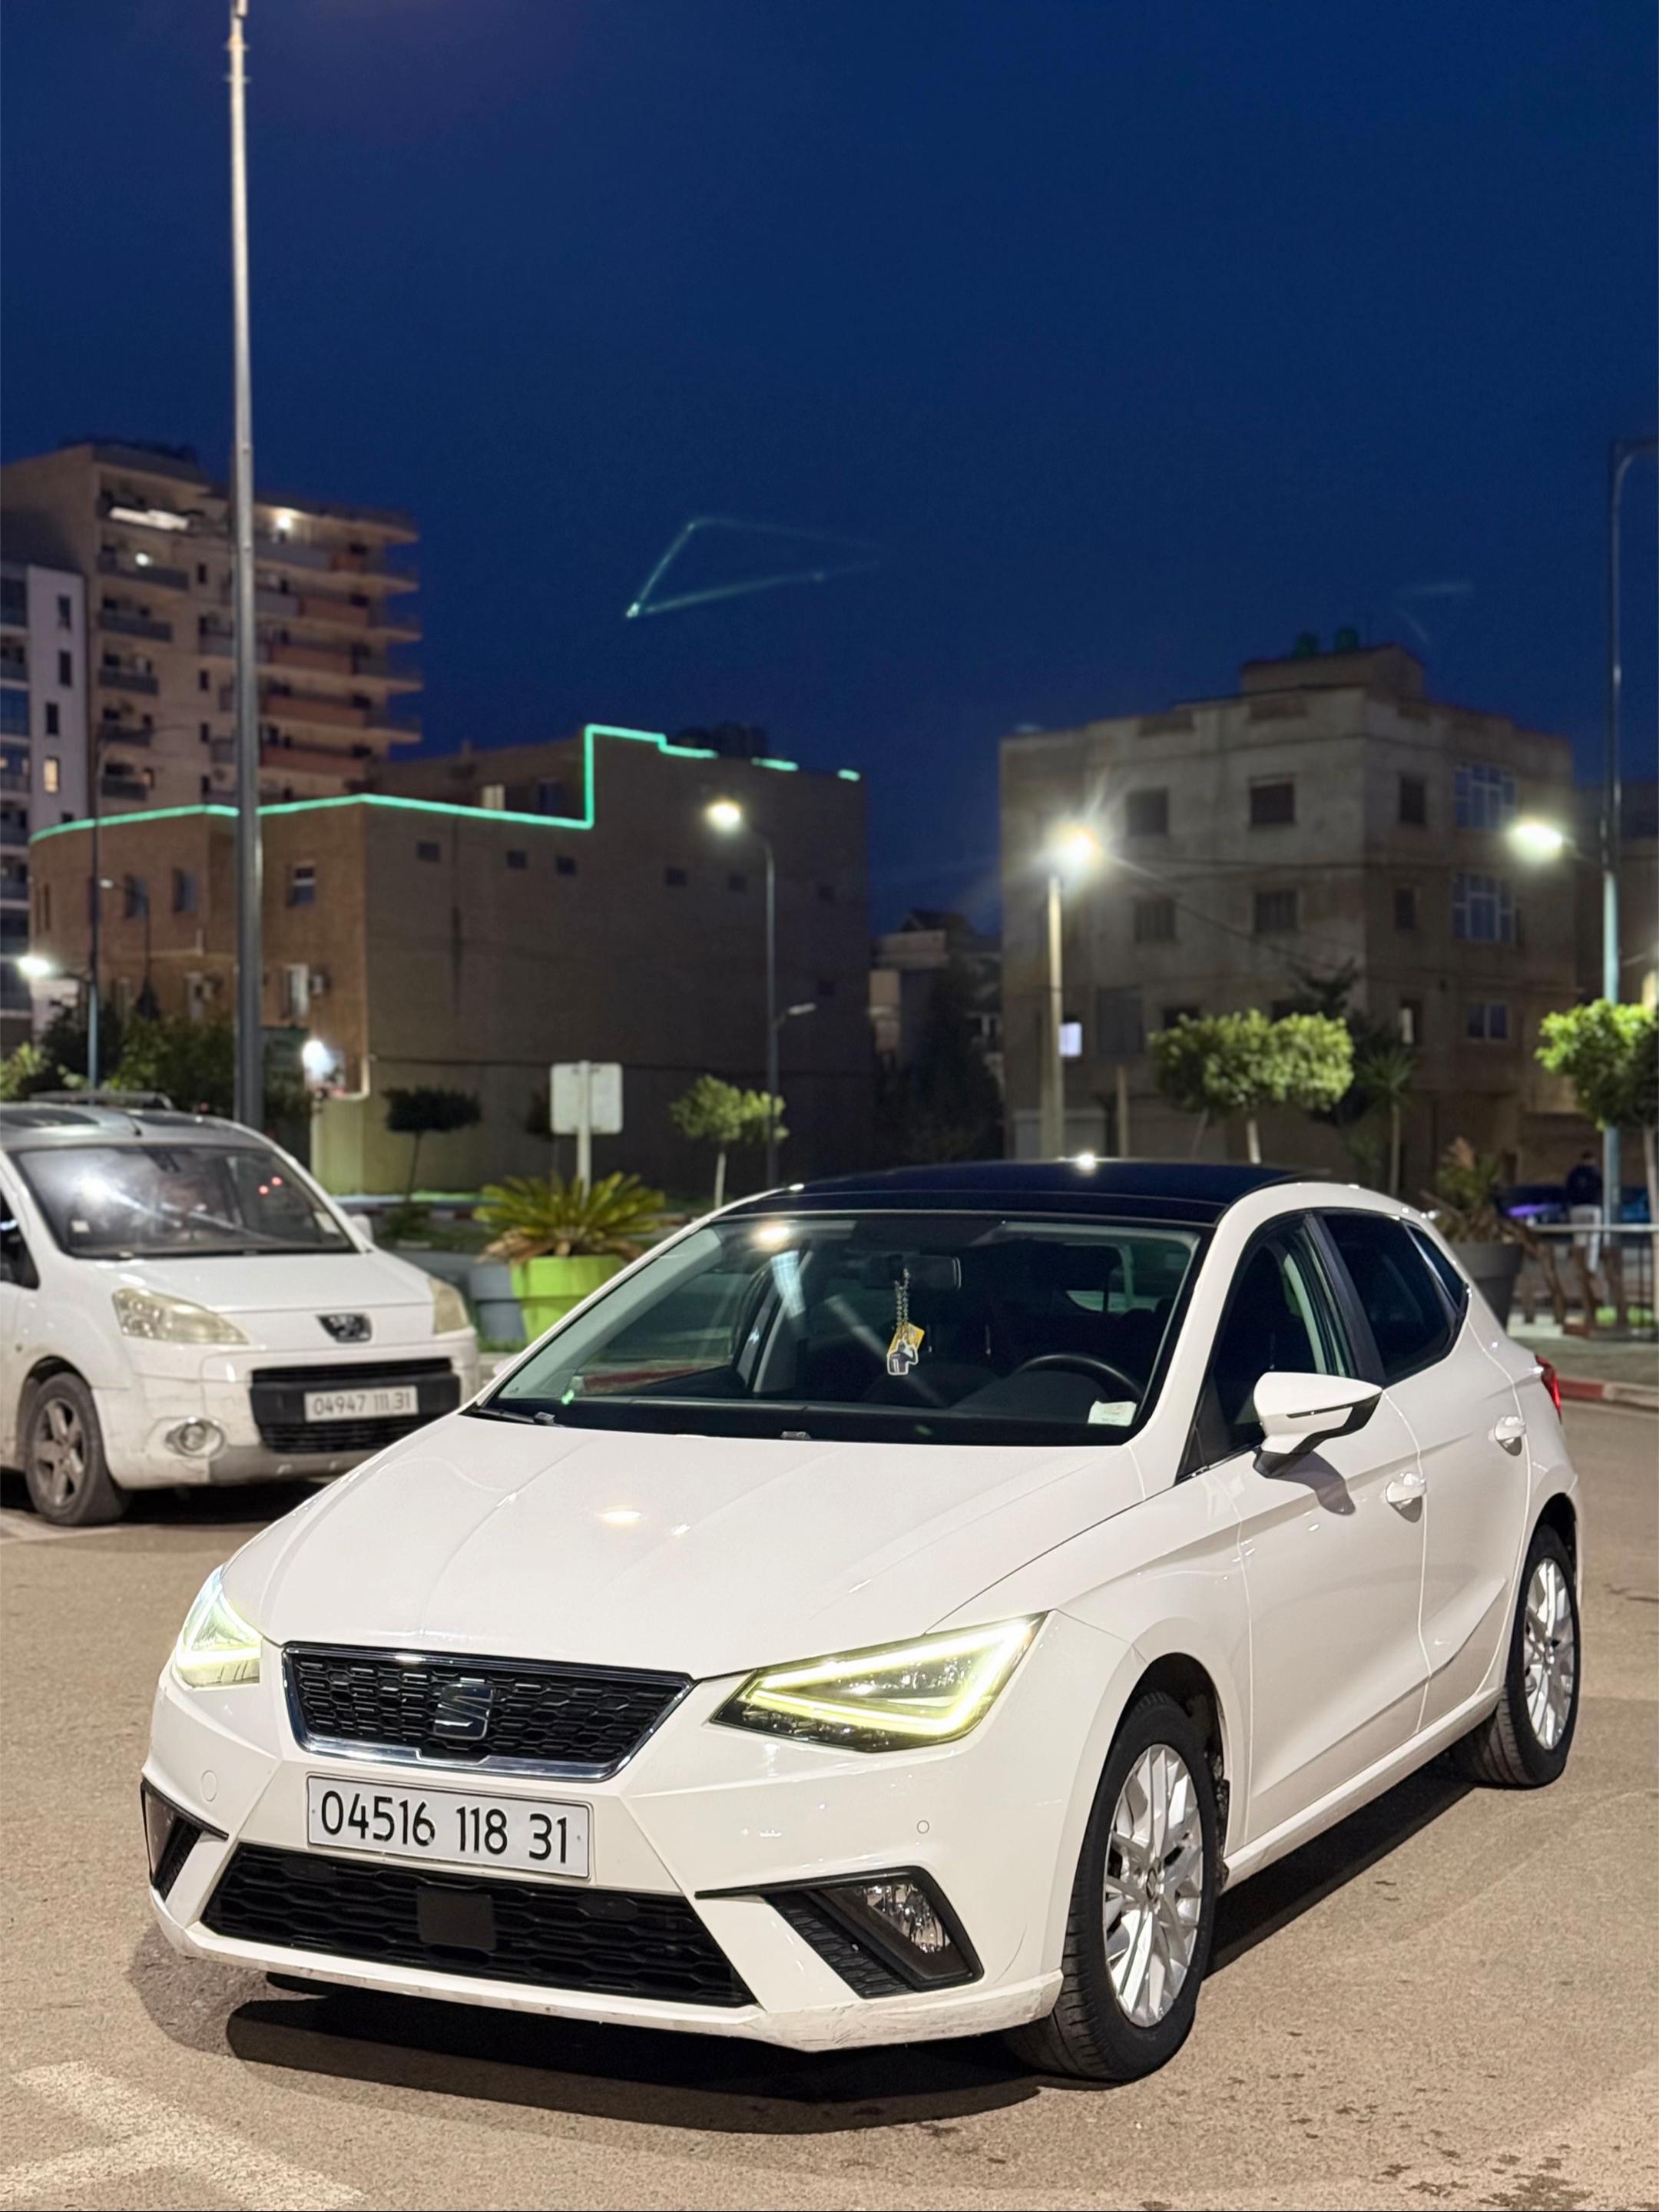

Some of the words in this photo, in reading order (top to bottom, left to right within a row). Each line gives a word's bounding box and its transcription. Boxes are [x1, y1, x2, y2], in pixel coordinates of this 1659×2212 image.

[313, 1394, 366, 1416] 04947
[393, 1391, 411, 1410] 31
[321, 1790, 435, 1846] 04516
[456, 1806, 508, 1855] 118
[528, 1813, 567, 1864] 31
